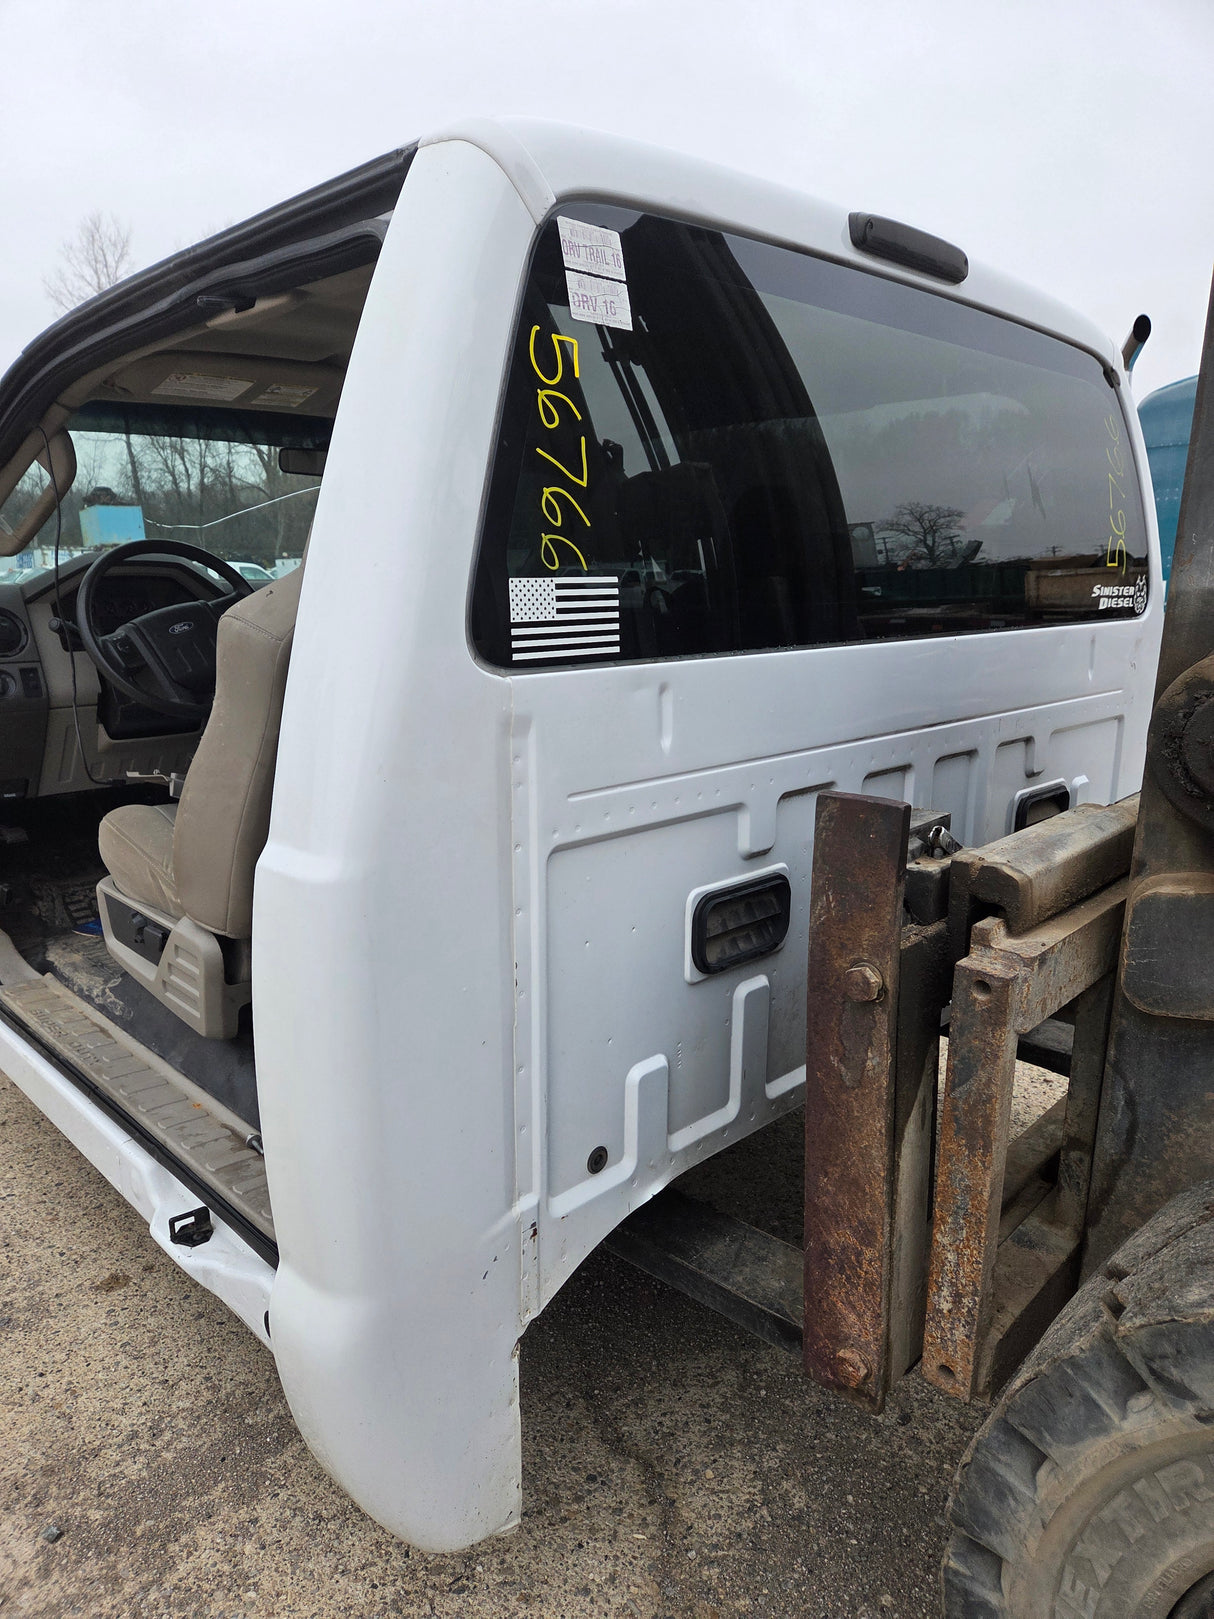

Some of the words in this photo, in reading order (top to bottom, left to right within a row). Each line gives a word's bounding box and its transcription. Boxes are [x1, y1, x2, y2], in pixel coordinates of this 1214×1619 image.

[561, 238, 581, 259] ORV
[582, 243, 609, 266] TRAIL
[611, 252, 622, 269] 16
[603, 299, 617, 317] 16
[529, 325, 591, 571] 56766
